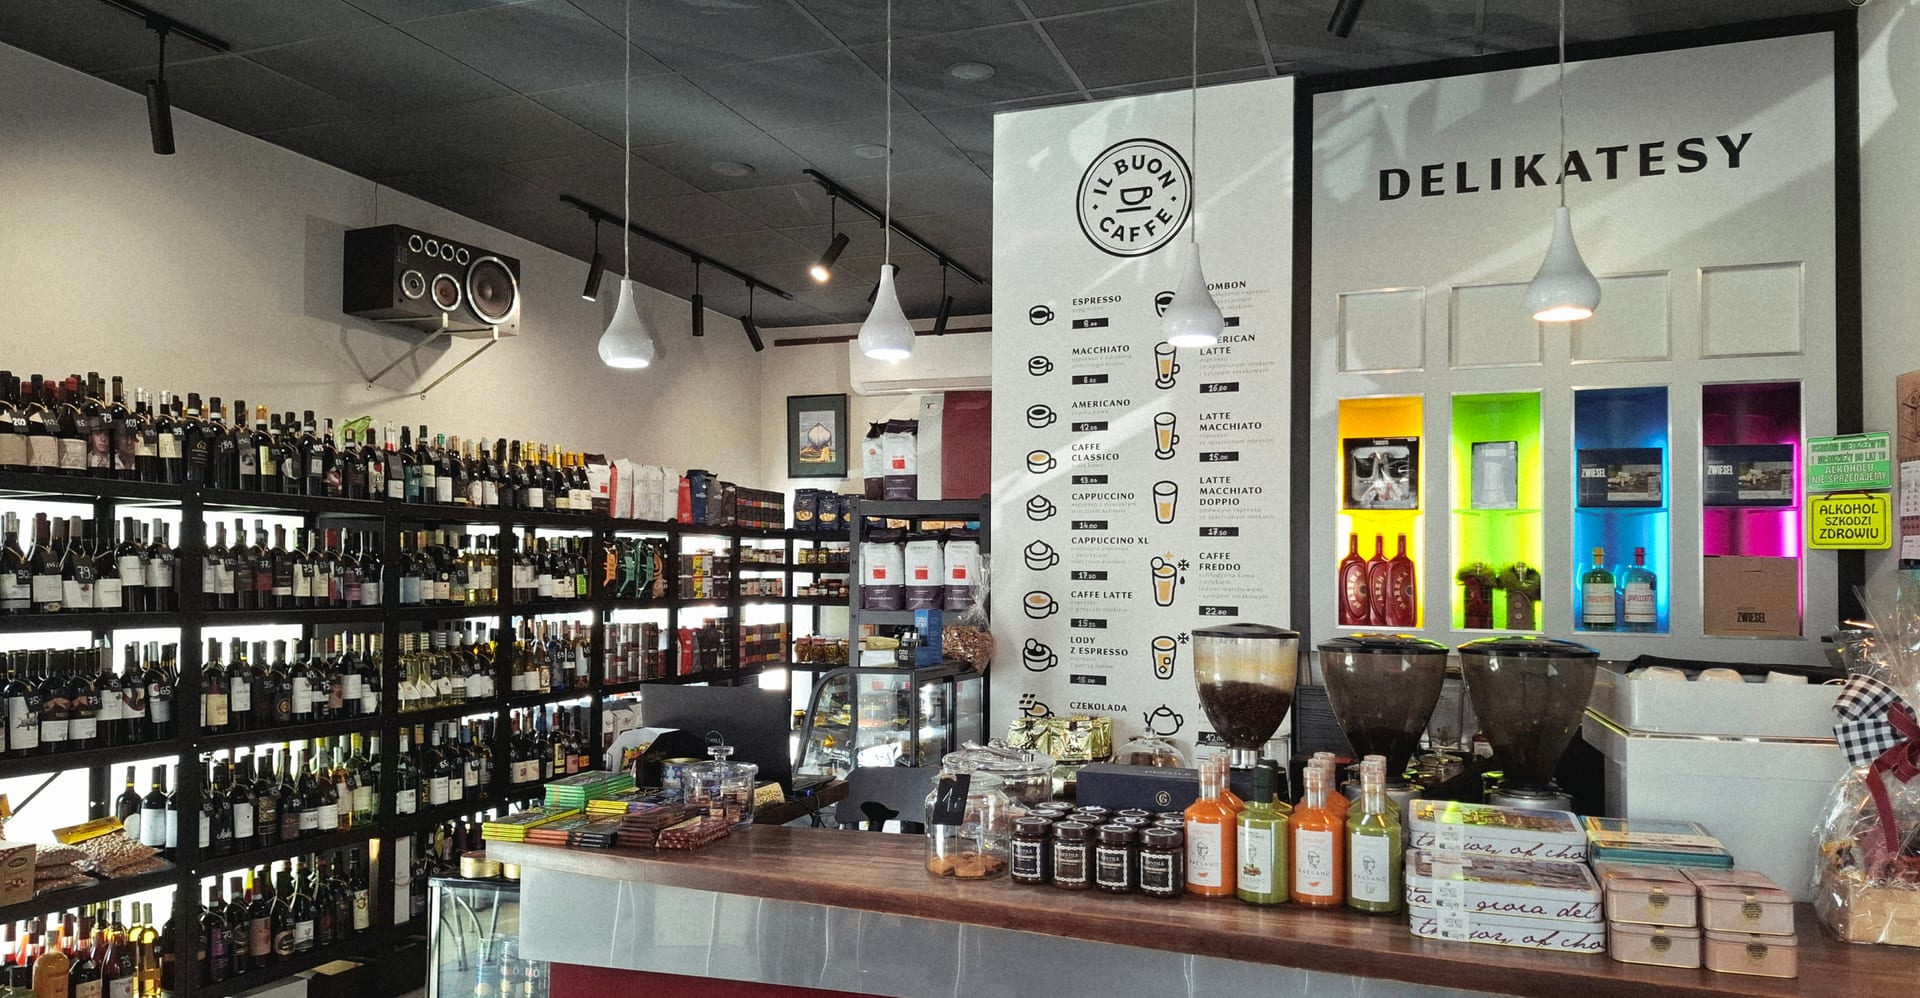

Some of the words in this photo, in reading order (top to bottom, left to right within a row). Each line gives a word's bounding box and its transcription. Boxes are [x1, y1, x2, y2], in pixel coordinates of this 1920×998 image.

[1379, 132, 1753, 201] DELIKATESY
[1093, 175, 1113, 195] IL
[1114, 154, 1176, 189] BUON
[1099, 207, 1173, 242] CAFFE
[1207, 281, 1246, 291] OMBON
[1073, 296, 1121, 305] ESPRESSO
[1217, 334, 1256, 344] ERICAN
[1073, 345, 1129, 354] MACCHIATO
[1200, 347, 1230, 355] LATTE
[1072, 399, 1130, 408] AMERICANO
[1200, 412, 1230, 420] LATTE
[1200, 422, 1261, 431] MACCHIATO
[1072, 443, 1101, 451] CAFFE
[1072, 453, 1120, 462] CLASSICO
[1581, 467, 1607, 478] ZWIESEL
[1707, 464, 1733, 475] ZWIESEL
[1825, 464, 1874, 474] ALKOHOLU
[1812, 475, 1825, 484] NIE
[1828, 472, 1886, 483] SPRZEDAJEMY
[1819, 504, 1879, 515] ALKOHOL
[1825, 516, 1872, 526] SZKODZI
[1819, 528, 1879, 539] ZDROWIU
[1737, 612, 1765, 623] ZWIESEL
[1079, 648, 1128, 656] ESPRESSO
[1070, 702, 1127, 714] CZEKOLADA
